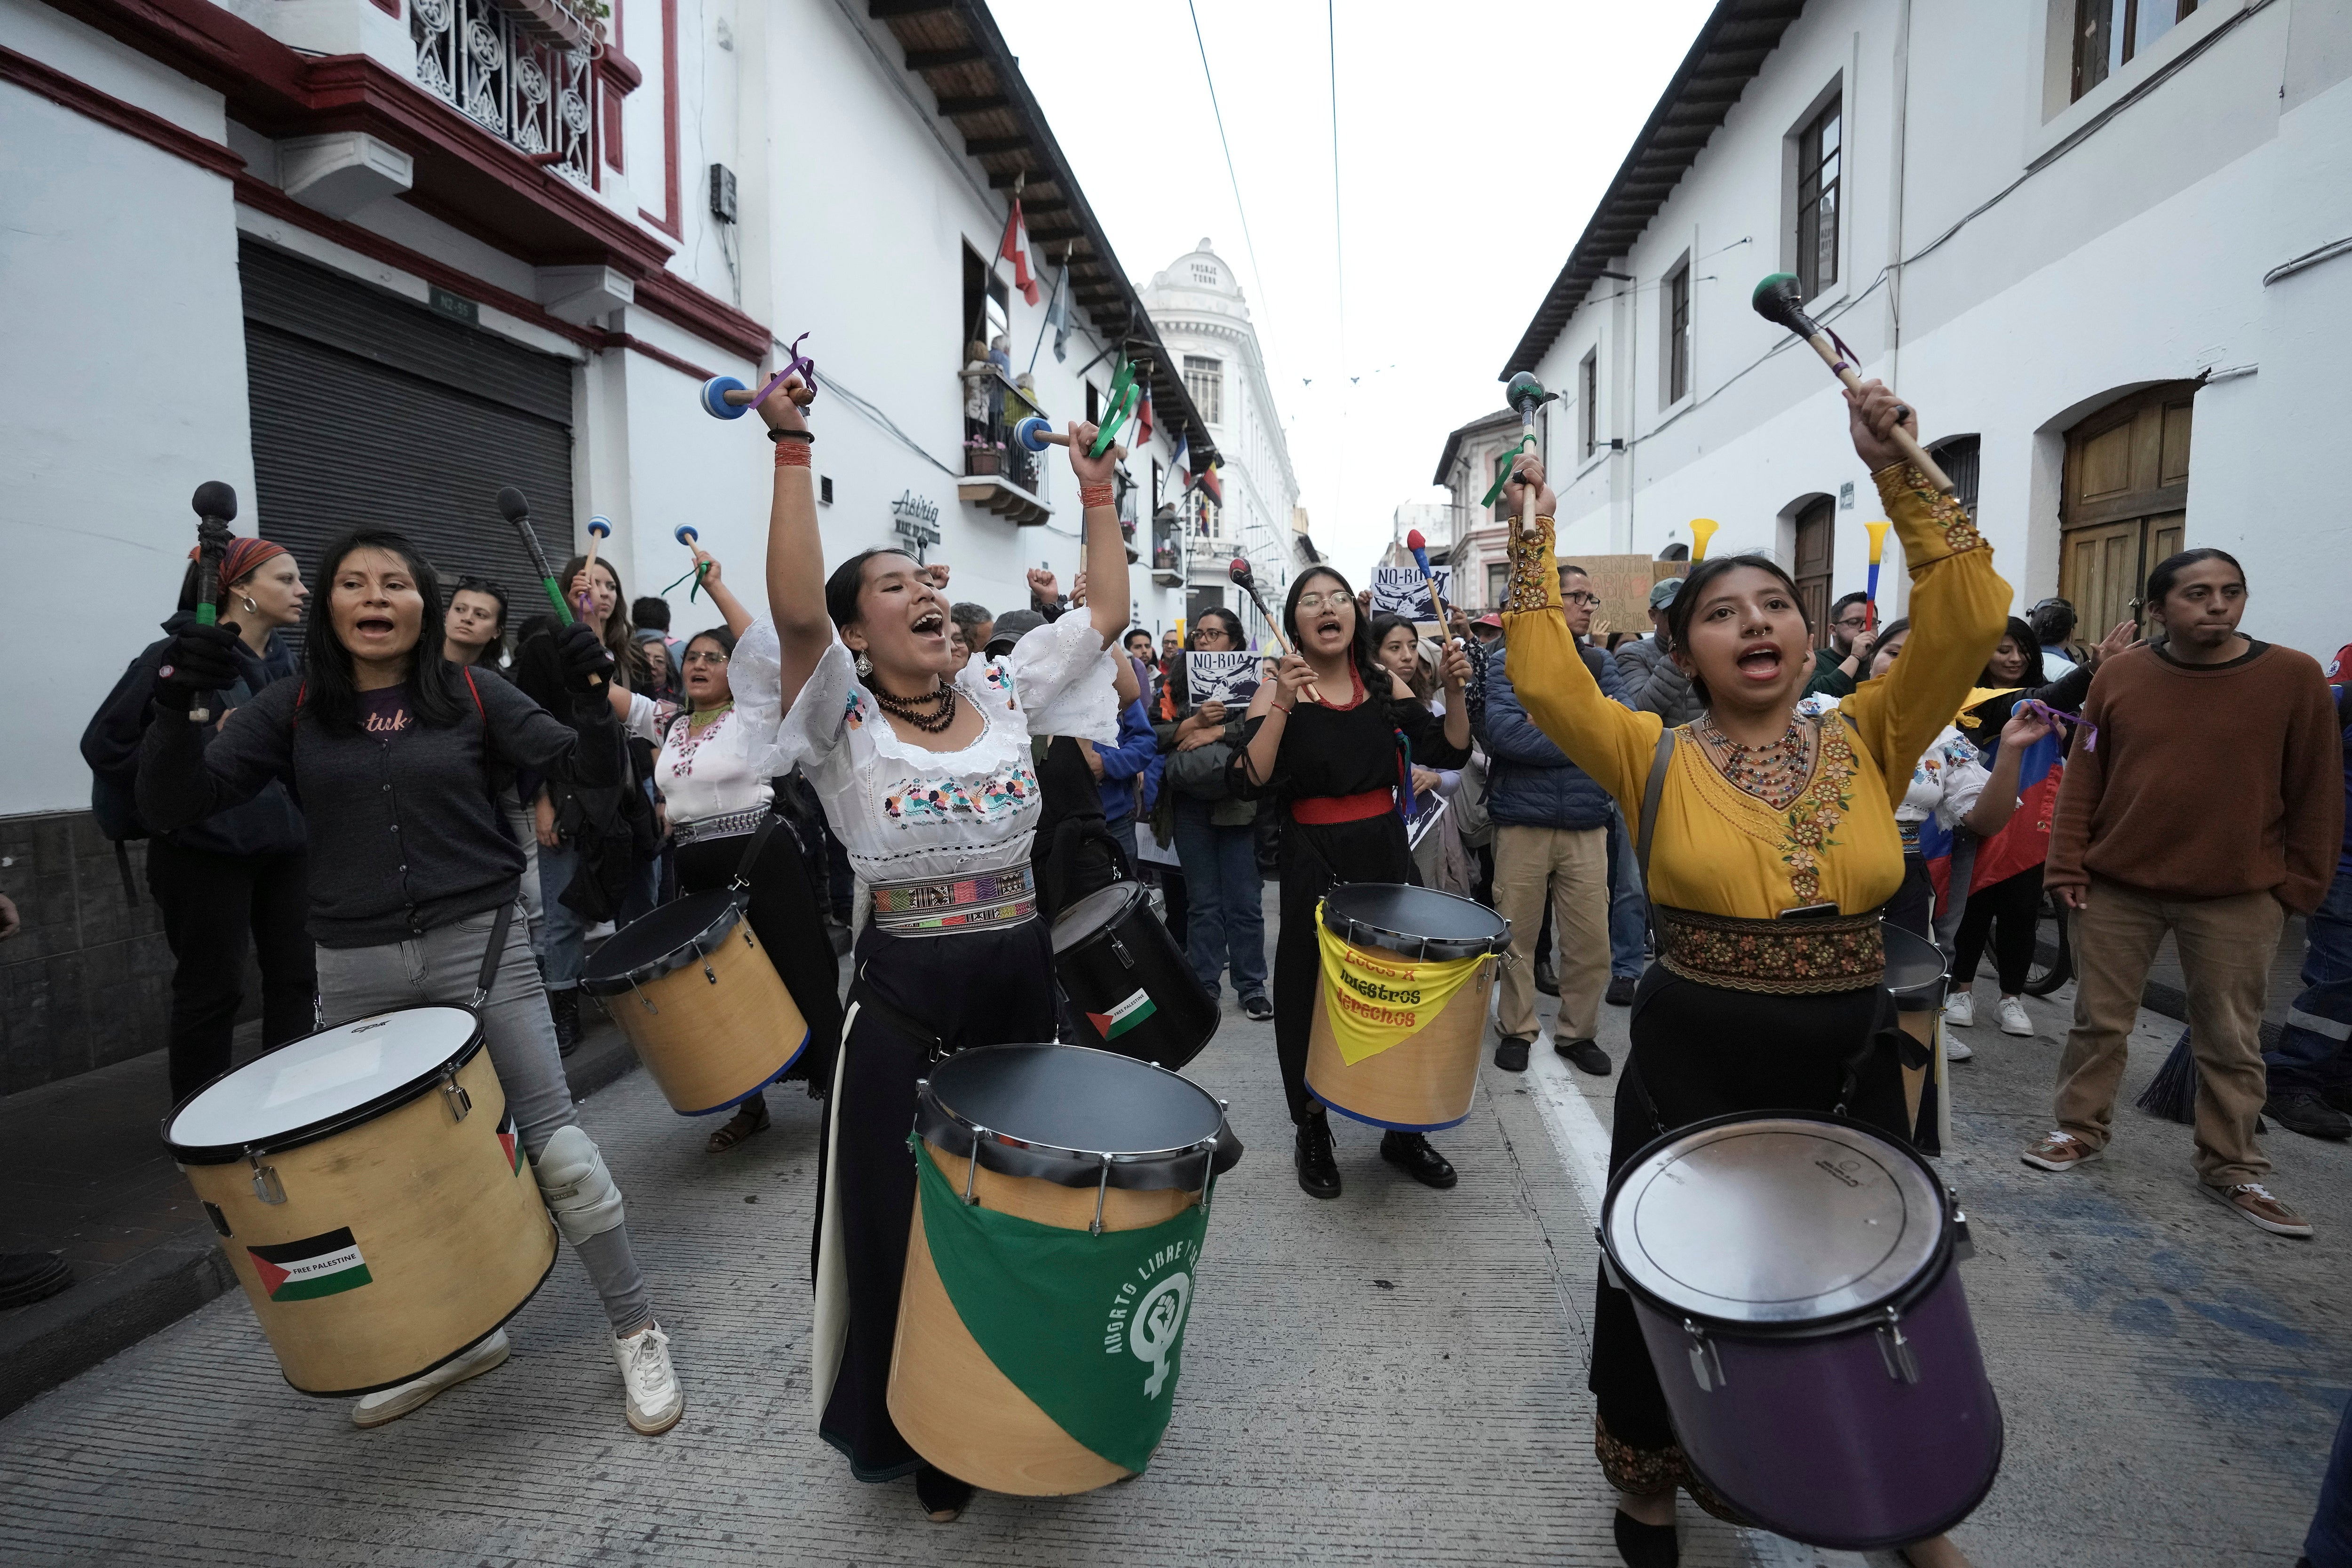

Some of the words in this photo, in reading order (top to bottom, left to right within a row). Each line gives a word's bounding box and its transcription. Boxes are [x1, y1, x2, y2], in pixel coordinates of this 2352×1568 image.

[1586, 556, 1650, 573] SENTIR
[1378, 568, 1423, 584] NO-BO
[1591, 573, 1634, 599] ABIA
[365, 709, 413, 732] tuk
[1124, 994, 1144, 1011] PALESTINE
[312, 1253, 357, 1270] PALESTINE
[1104, 1283, 1137, 1353] ABORTO
[1138, 1241, 1183, 1281] LIBRE
